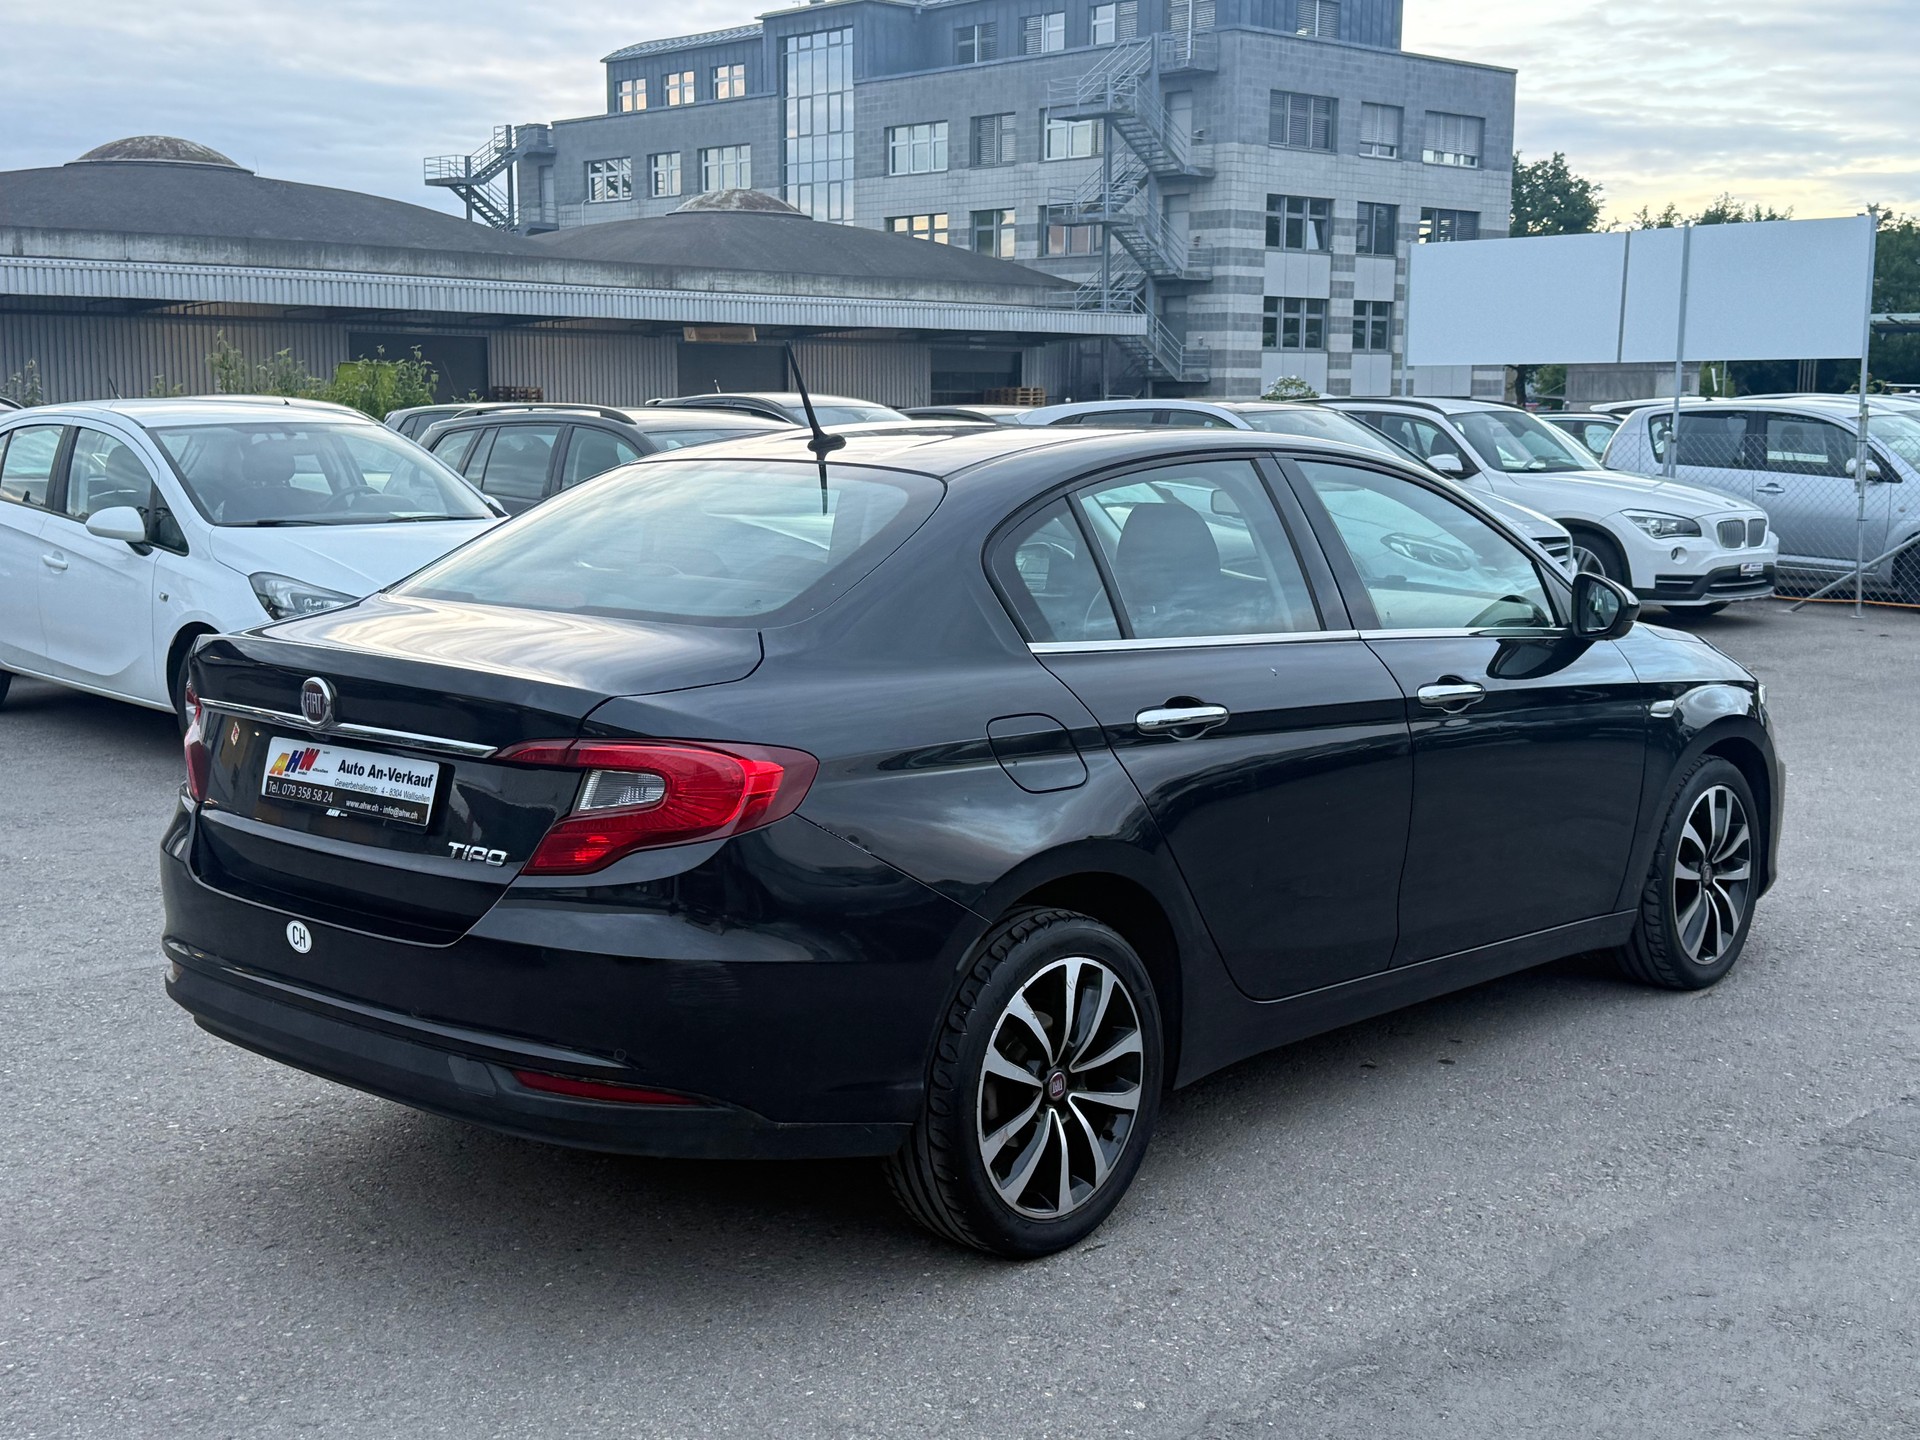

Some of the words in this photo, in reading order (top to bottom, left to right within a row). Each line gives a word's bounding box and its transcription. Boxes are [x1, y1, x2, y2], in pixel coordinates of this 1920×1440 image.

[306, 692, 323, 714] FIAT
[269, 747, 320, 776] AHW
[338, 759, 365, 776] Auto
[367, 764, 434, 788] An-Verkauf
[268, 780, 280, 794] Tel.
[281, 783, 296, 797] 079
[297, 786, 312, 800] 358
[312, 788, 322, 801] 58
[323, 790, 333, 803] 24
[388, 787, 402, 797] 8304
[403, 790, 431, 802] Wallisellen
[345, 800, 379, 812] www.ahw.ch
[383, 805, 418, 820] info@ahw.ch
[448, 841, 507, 867] TIPO
[292, 925, 306, 948] CH
